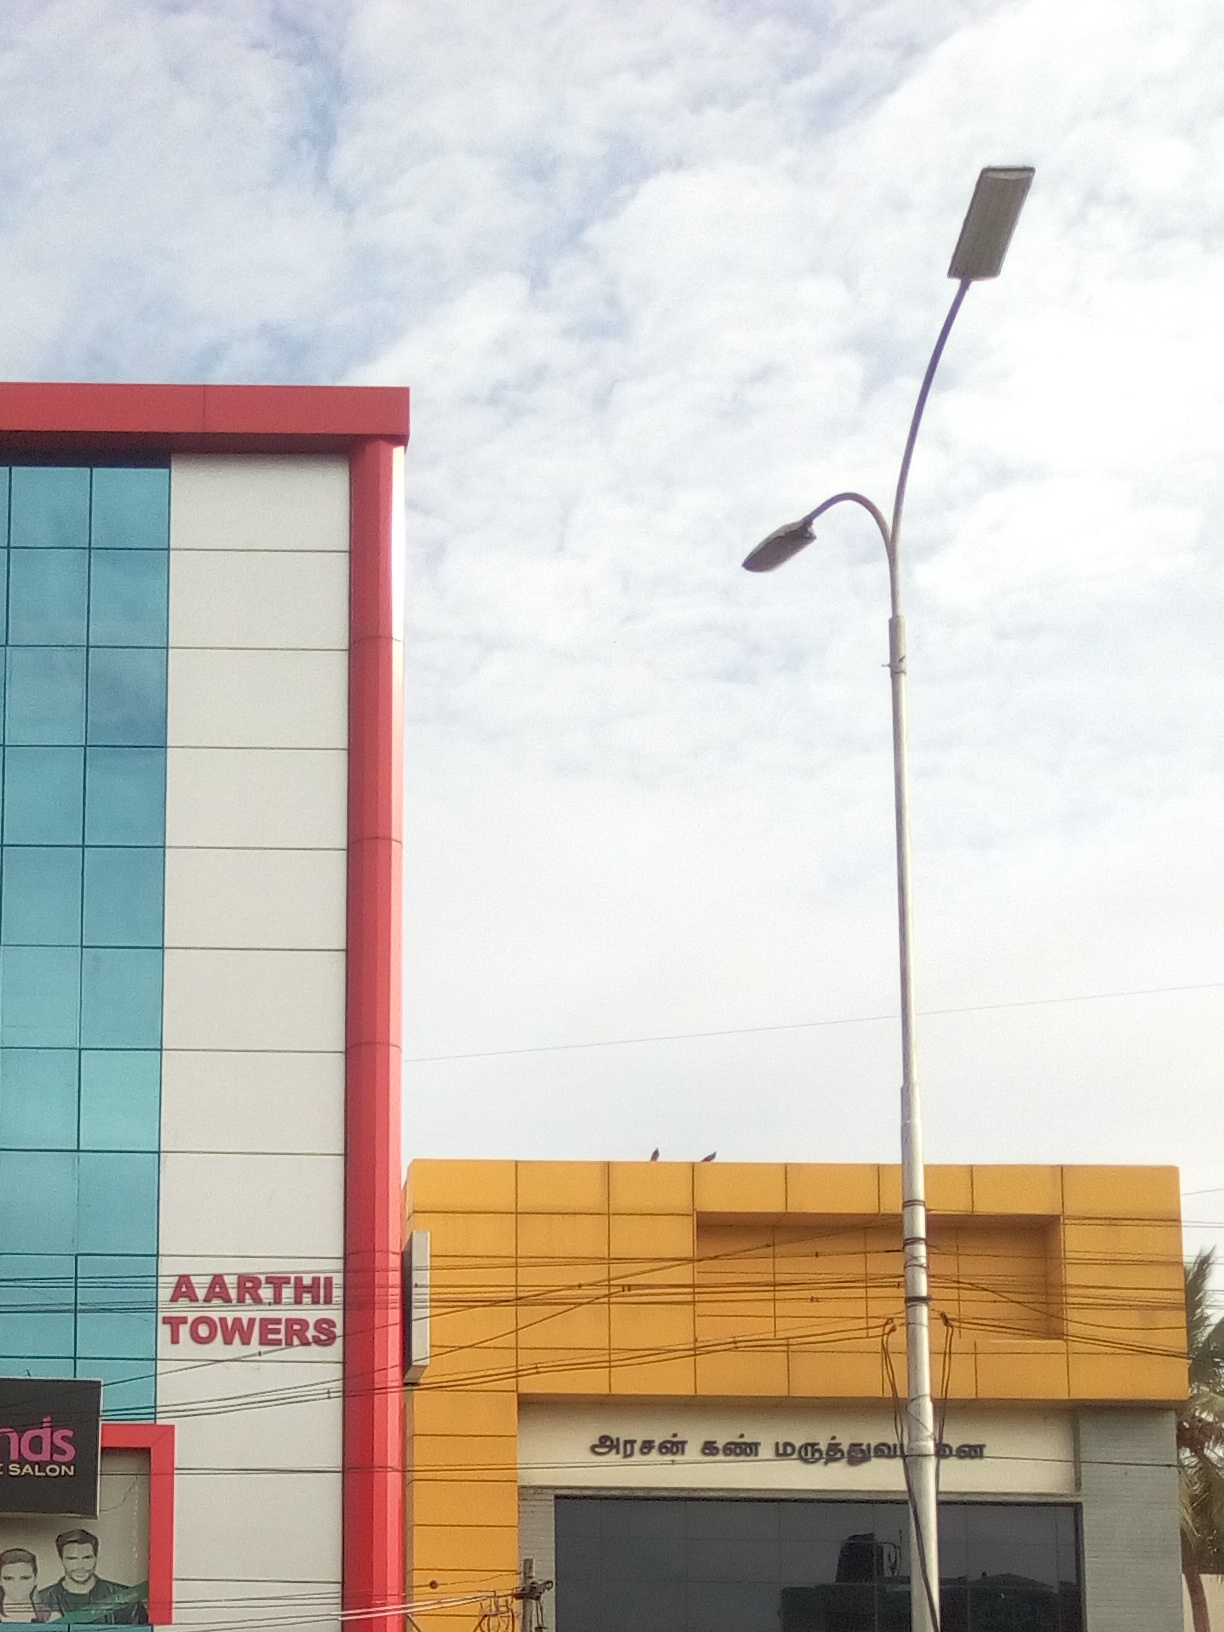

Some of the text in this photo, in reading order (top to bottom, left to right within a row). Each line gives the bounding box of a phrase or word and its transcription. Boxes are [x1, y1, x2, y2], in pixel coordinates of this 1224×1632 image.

[169, 1273, 334, 1305] AARTHI
[162, 1315, 337, 1347] TOWERS
[590, 1433, 986, 1466] அரசன் கண் மருத்துவனை
[8, 1463, 75, 1477] SALON
